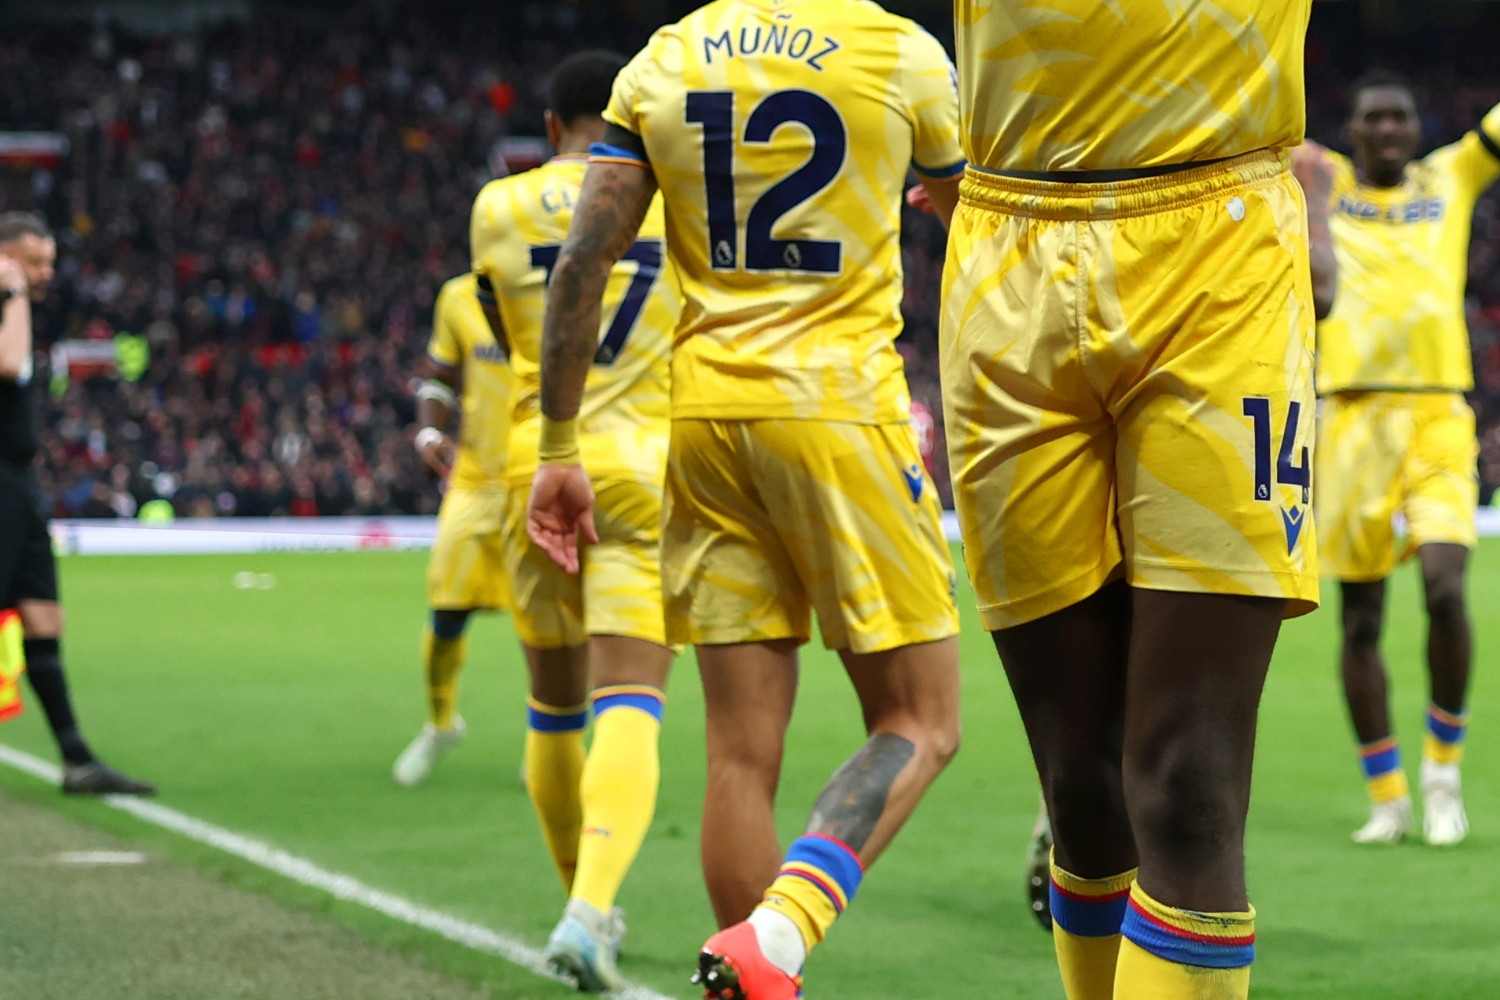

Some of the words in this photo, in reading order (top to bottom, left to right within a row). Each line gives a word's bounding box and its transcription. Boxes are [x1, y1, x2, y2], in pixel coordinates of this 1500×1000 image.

[704, 12, 841, 72] MUÑOZ
[685, 87, 848, 274] 12
[1242, 397, 1311, 505] 14
